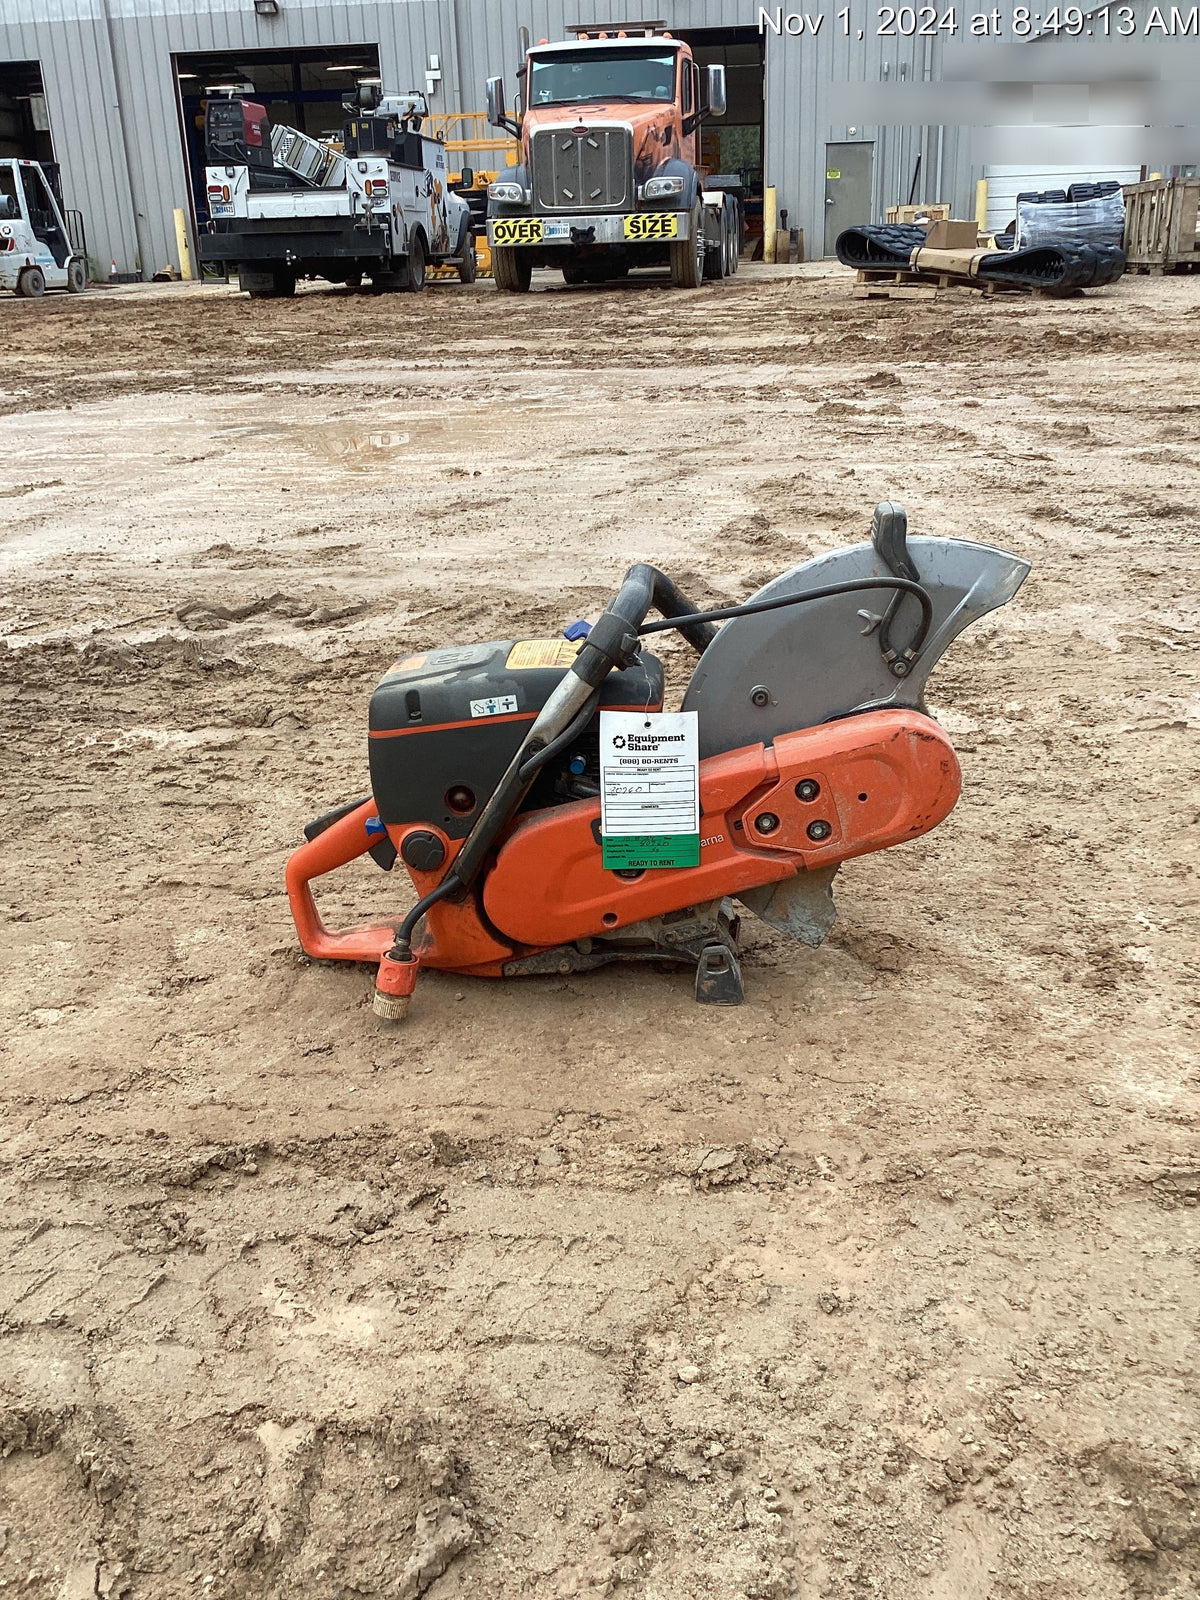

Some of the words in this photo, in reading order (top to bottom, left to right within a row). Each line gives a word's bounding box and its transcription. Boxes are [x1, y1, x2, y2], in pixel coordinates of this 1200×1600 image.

[494, 223, 542, 239] OVER
[629, 218, 672, 234] SIZE
[627, 734, 686, 743] Equipment
[627, 743, 659, 751] Share
[700, 834, 724, 849] arna
